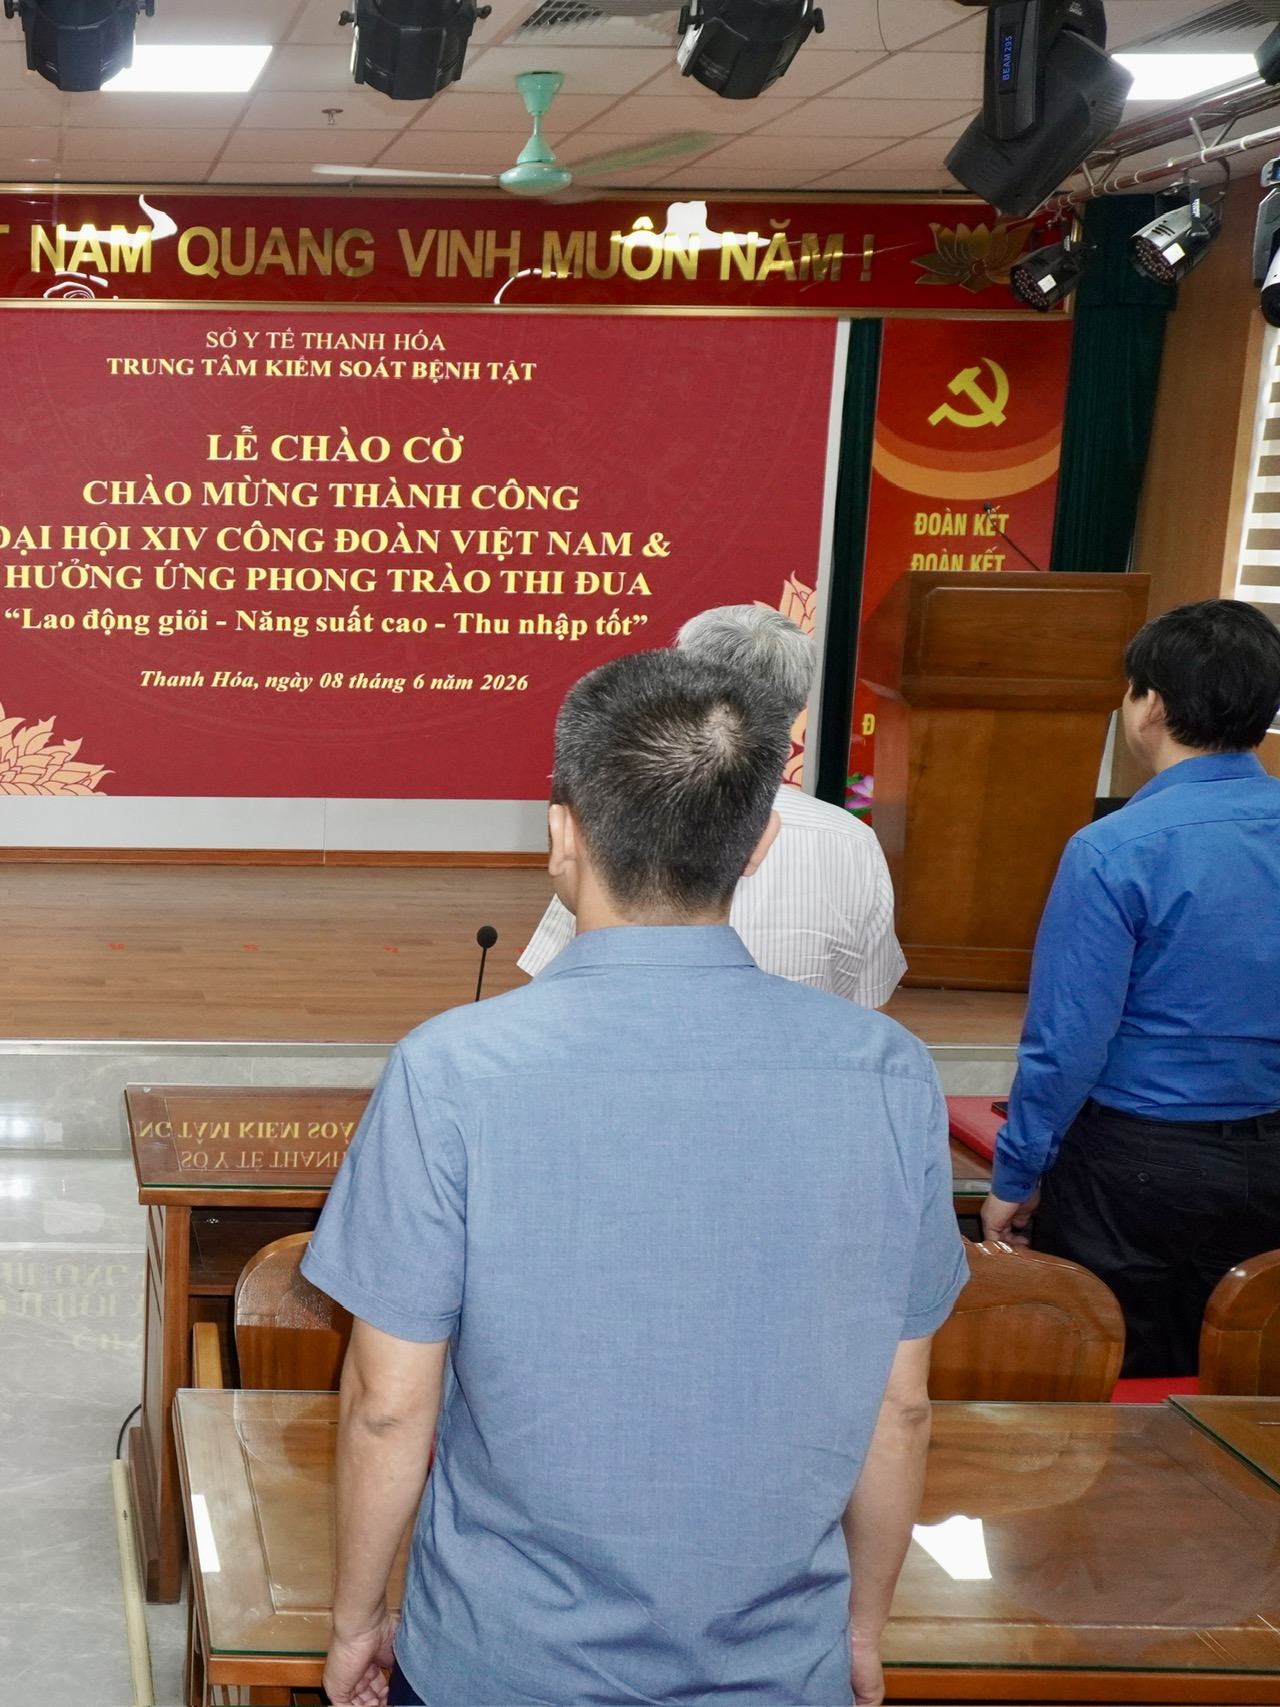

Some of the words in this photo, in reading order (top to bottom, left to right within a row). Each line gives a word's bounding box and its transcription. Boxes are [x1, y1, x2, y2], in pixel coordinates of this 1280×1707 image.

[1002, 53, 1011, 81] BEAM
[31, 224, 152, 273] NAM
[177, 226, 375, 279] QUANG
[398, 228, 521, 278] VINH
[542, 216, 700, 280] MUÔN
[719, 218, 845, 281] NĂM
[860, 234, 875, 282] !
[206, 327, 237, 348] SỞ
[243, 332, 260, 348] Y
[266, 327, 295, 349] TẾ
[301, 332, 385, 350] THANH
[394, 329, 446, 350] HÓA
[107, 358, 194, 375] TRUNG
[201, 355, 257, 376] TÂM
[265, 355, 332, 377] KIỂM
[339, 356, 406, 378] SOÁT
[412, 359, 481, 383] BỆNH
[487, 360, 537, 385] TẬT
[206, 425, 259, 461] LỄ
[271, 426, 390, 462] CHÀO
[403, 427, 464, 463] CỜ
[83, 474, 192, 505] CHÀO
[201, 475, 319, 507] MỪNG
[329, 476, 461, 508] THÀNH
[472, 478, 580, 510] CÔNG
[914, 507, 967, 536] ĐOÀN
[973, 505, 1009, 536] KẾT
[61, 522, 131, 556] HỘI
[141, 526, 208, 551] XIV
[217, 520, 325, 552] CÔNG
[334, 522, 441, 554] ĐOÀN
[451, 526, 538, 561] VIỆT
[547, 531, 632, 556] NAM
[642, 532, 670, 557] &
[911, 548, 964, 571] ĐOÀN
[970, 546, 1006, 571] KẾT
[4, 558, 143, 589] HƯỞNG
[154, 559, 236, 590] ỨNG
[246, 567, 377, 592] PHONG
[387, 562, 491, 593] TRÀO
[500, 570, 564, 594] THI
[574, 571, 652, 595] ĐUA
[5, 608, 75, 630] “Lao
[82, 608, 150, 635] động
[158, 609, 208, 636] giỏi
[235, 610, 309, 637] Năng
[316, 605, 374, 632] suất
[381, 617, 427, 633] cao
[454, 613, 510, 634] Thu
[519, 613, 588, 641] nhập
[595, 607, 648, 636] tốt”
[140, 670, 204, 687] Thanh
[210, 671, 259, 690] Hóa,
[264, 672, 314, 693] ngày
[319, 672, 344, 689] 08
[349, 672, 406, 694] tháng
[412, 674, 425, 690] 6
[430, 673, 474, 690] năm
[479, 674, 529, 691] 2026
